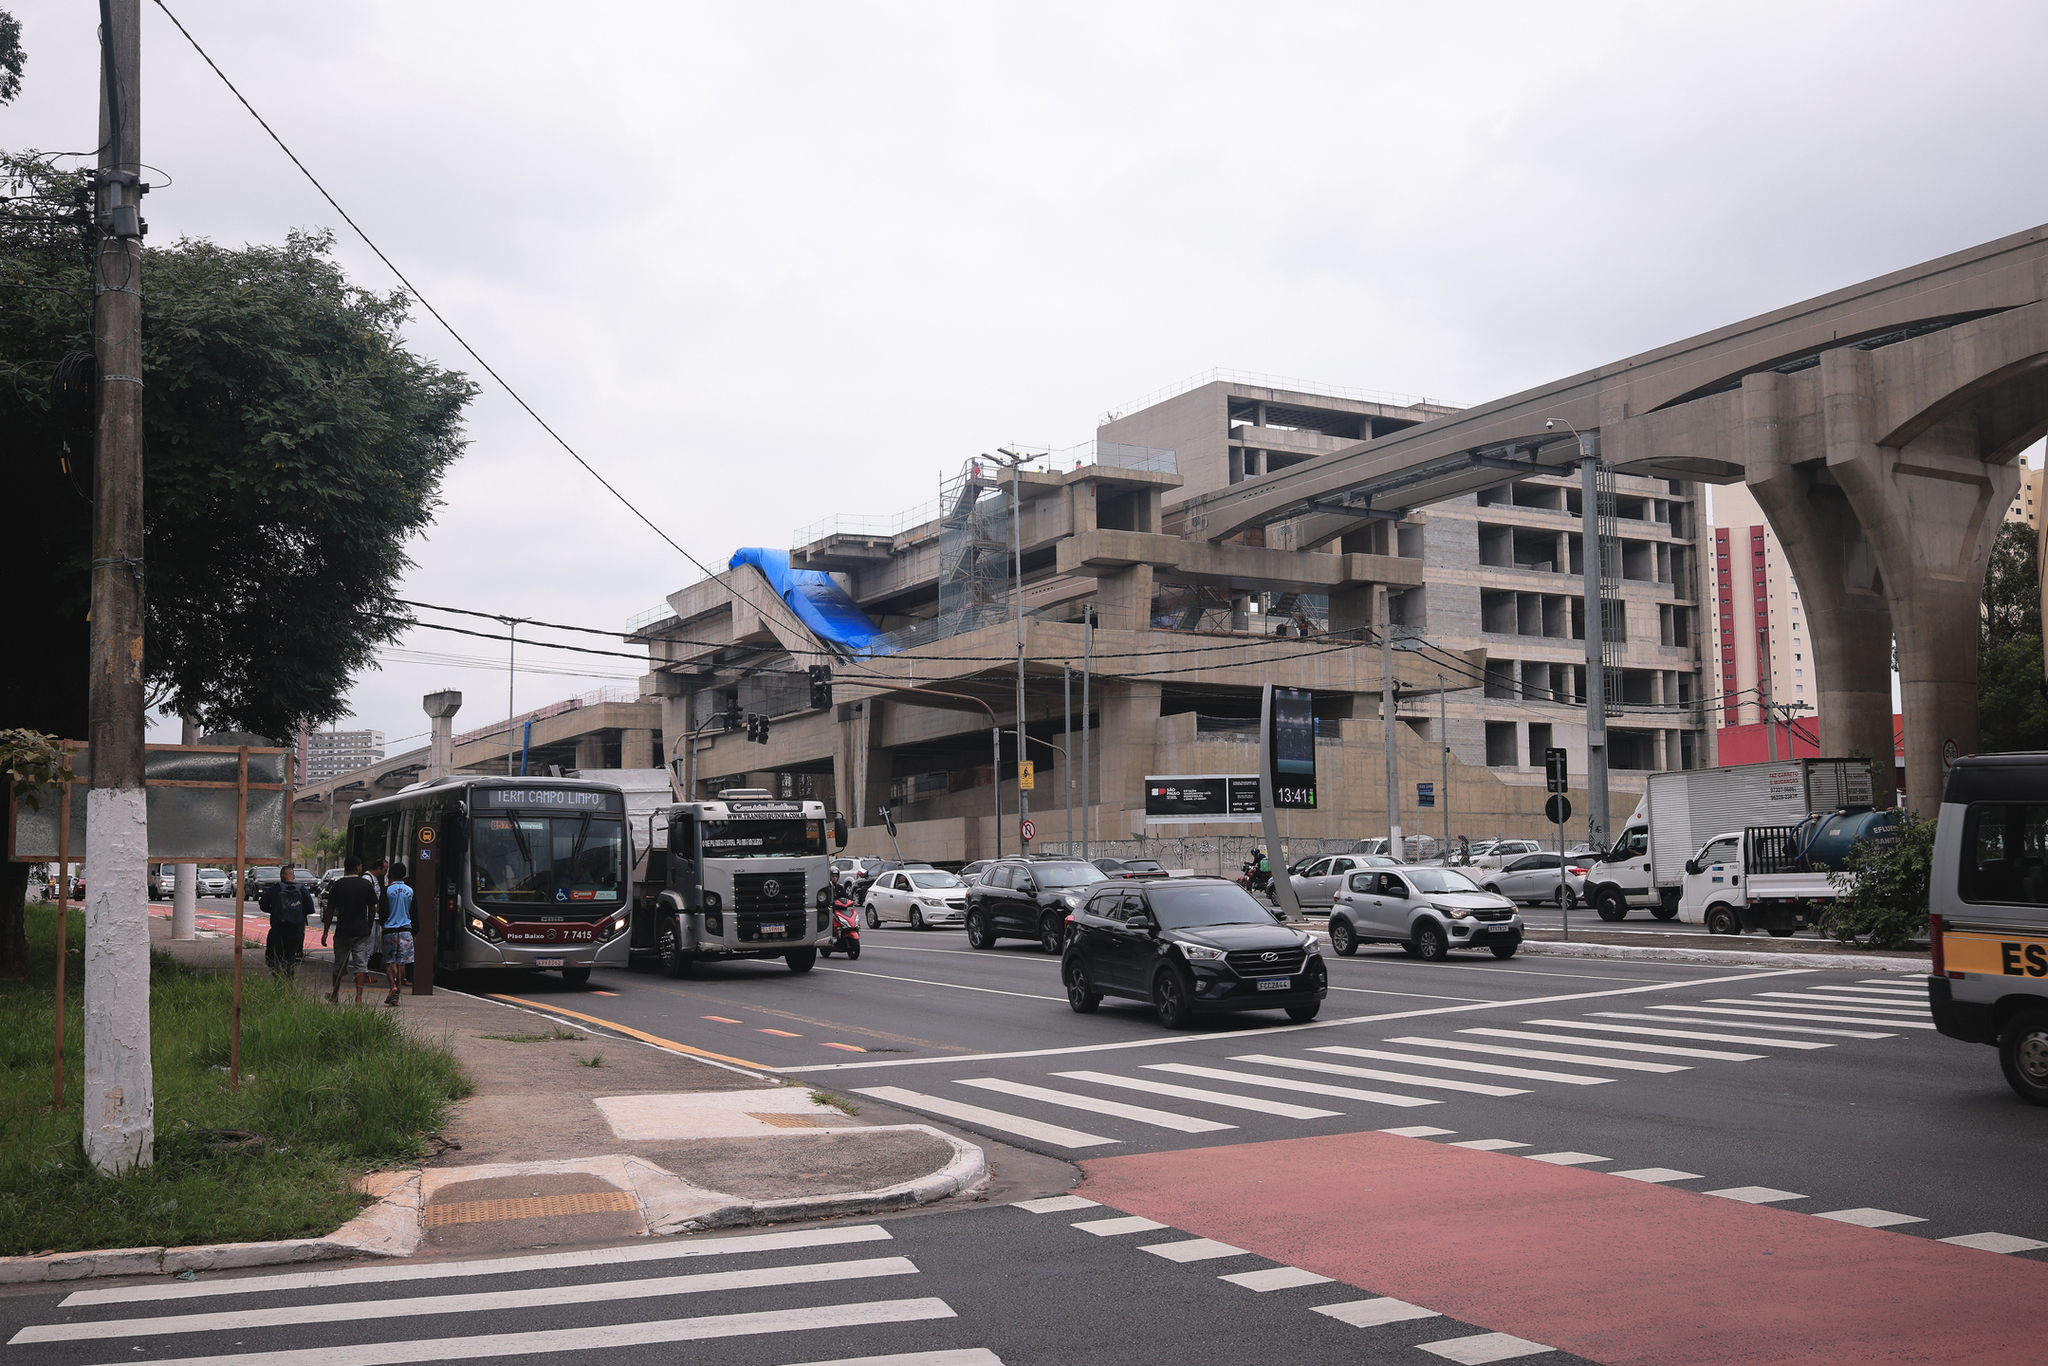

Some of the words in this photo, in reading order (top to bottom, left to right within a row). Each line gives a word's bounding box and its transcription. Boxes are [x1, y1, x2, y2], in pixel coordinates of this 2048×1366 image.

[528, 790, 564, 804] CAMPO
[568, 791, 599, 805] LIMPO
[1278, 787, 1307, 803] 13:41
[732, 802, 799, 812] Constellation
[563, 930, 570, 940] 7
[572, 930, 592, 939] 7415
[2001, 942, 2048, 978] ES
